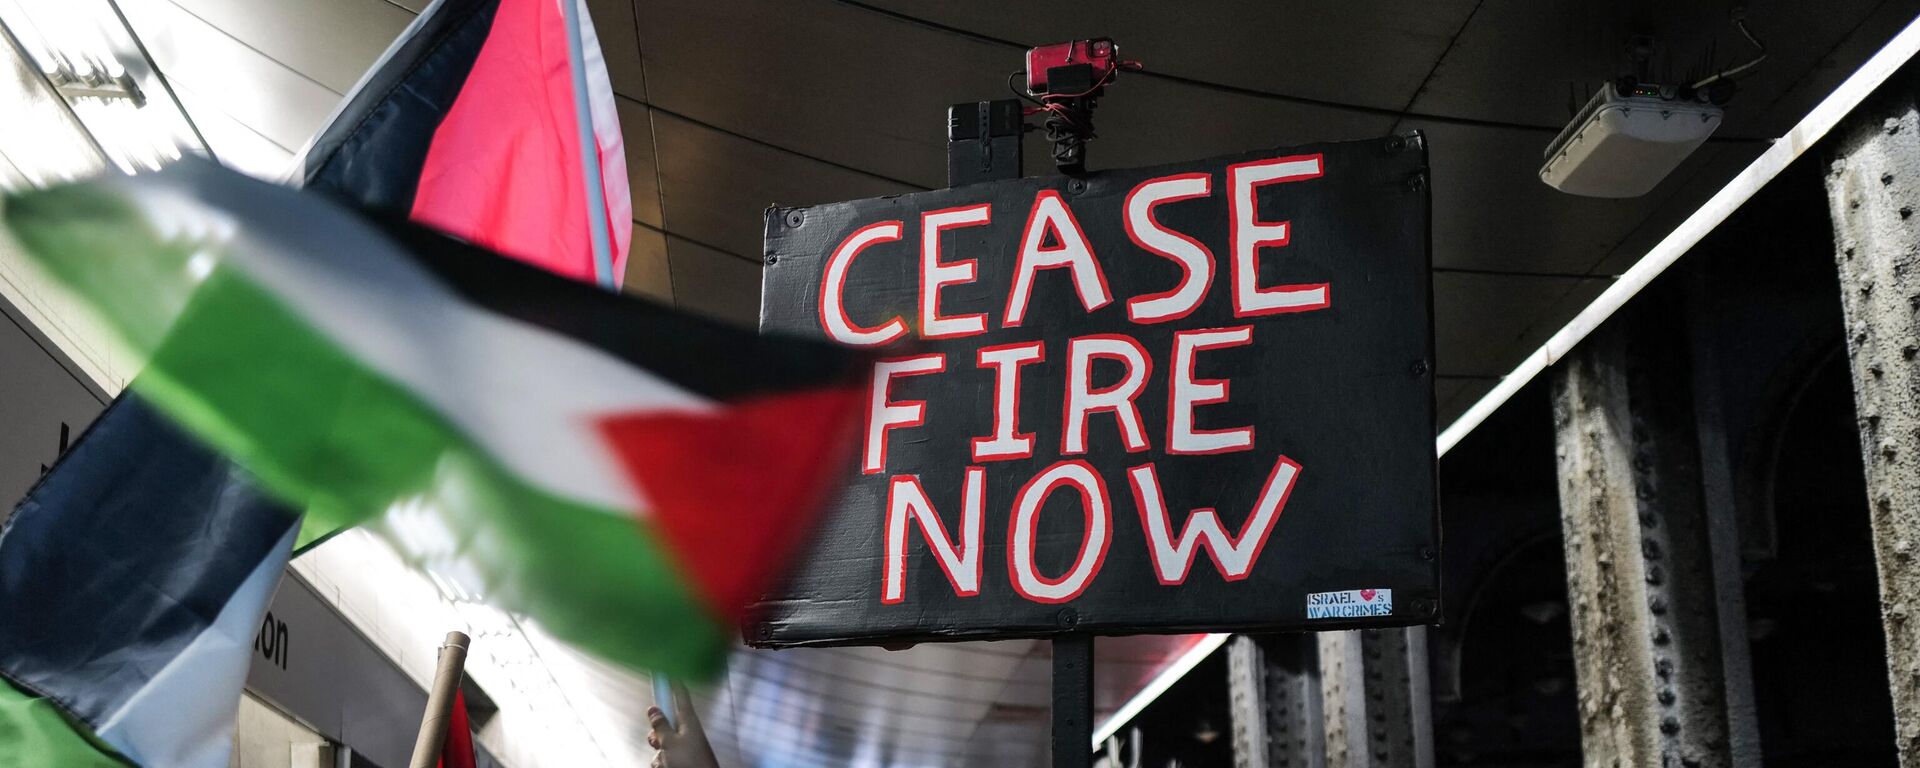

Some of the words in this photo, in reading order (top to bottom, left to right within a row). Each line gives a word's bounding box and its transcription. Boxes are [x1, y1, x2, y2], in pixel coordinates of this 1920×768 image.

[819, 154, 1330, 346] CEASE
[862, 326, 1255, 474] FIRE
[881, 456, 1303, 604] NOW
[1308, 592, 1356, 606] ISRAEL
